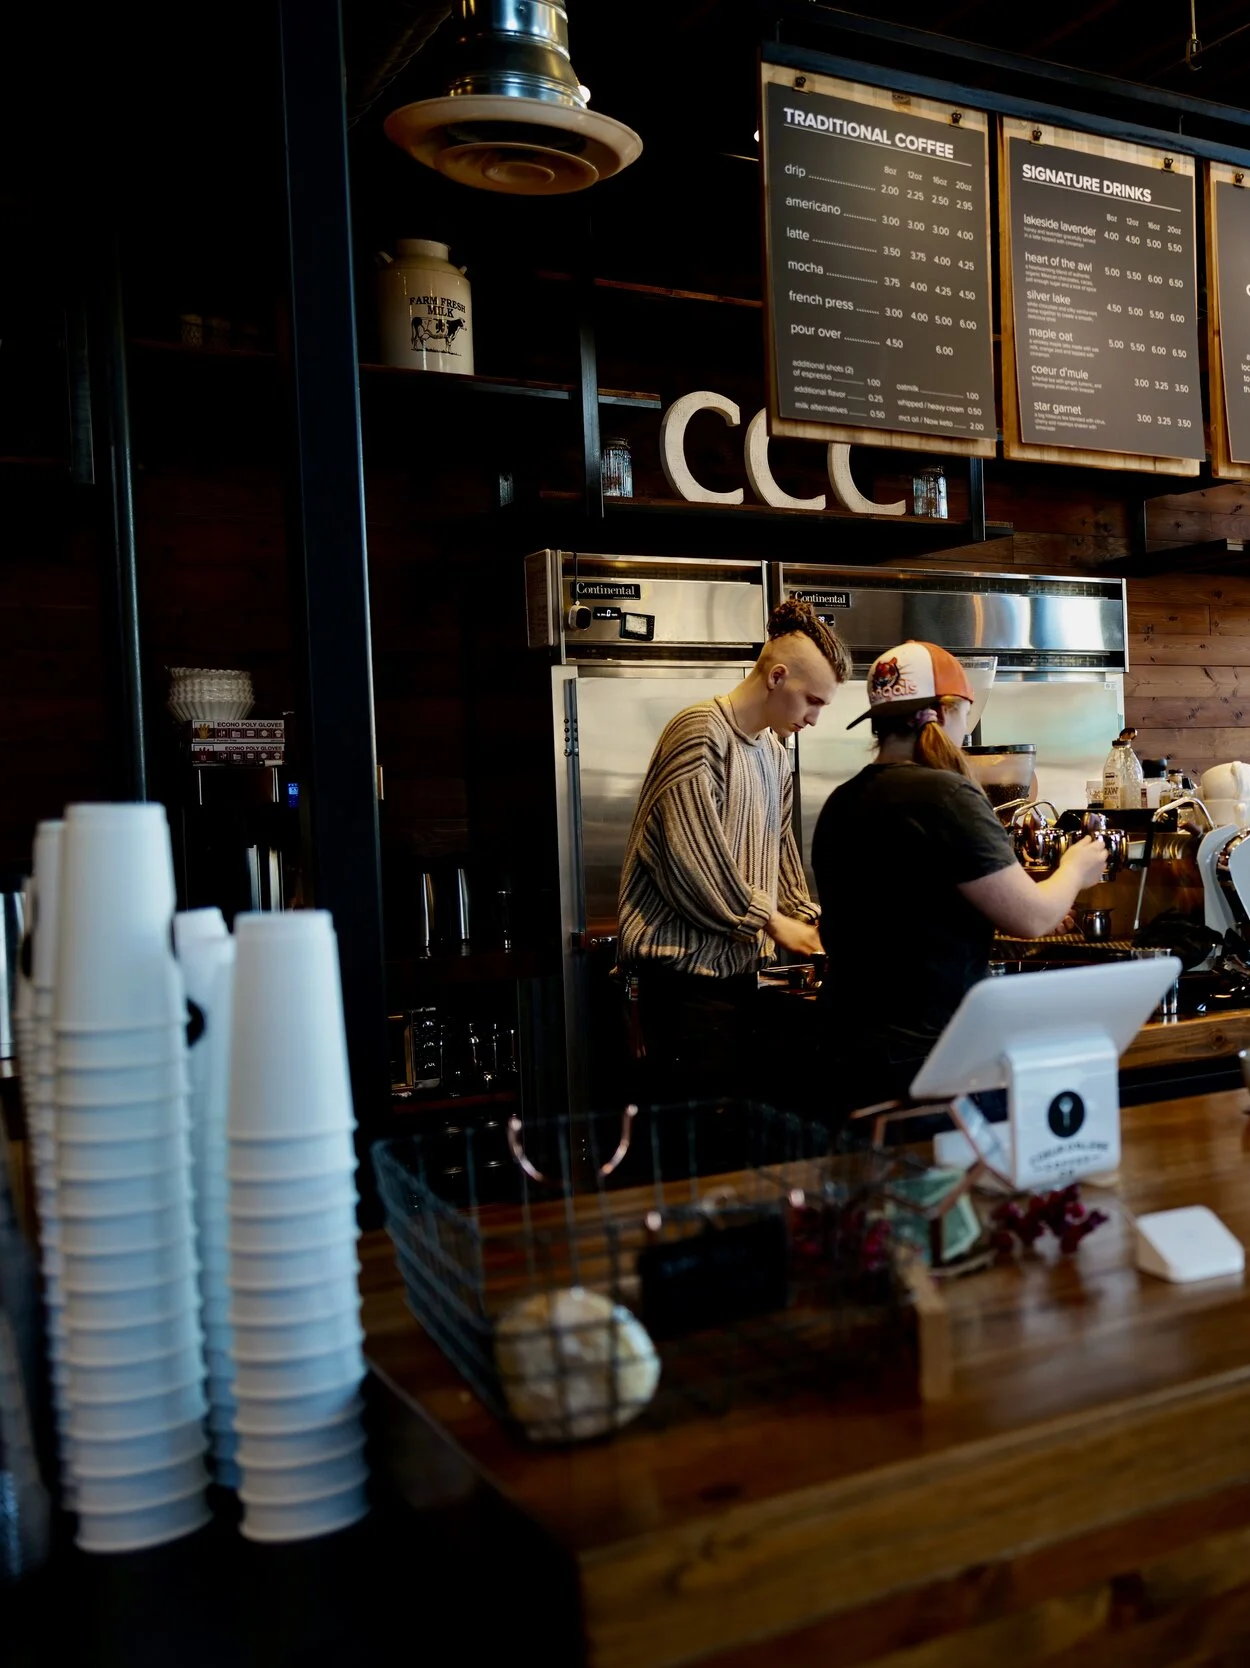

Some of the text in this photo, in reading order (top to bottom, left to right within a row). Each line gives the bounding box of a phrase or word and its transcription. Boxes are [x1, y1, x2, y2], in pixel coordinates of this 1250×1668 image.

[784, 108, 953, 158] TRADITIONAL COFFEE
[884, 166, 972, 191] 8oz 12oz 16oz 20oz
[1022, 164, 1151, 202] SIGNATURE DRINKS
[785, 164, 973, 211] drip 2.00 2.25 2.50 2.95
[786, 197, 841, 215] americano
[787, 227, 810, 241] latte
[1024, 214, 1059, 230] lakeside
[1060, 221, 1096, 236] lavender
[1104, 231, 1119, 241] 4.00
[1125, 235, 1140, 245] 4.50
[1146, 238, 1162, 249] 5.00
[1168, 243, 1182, 253] 5.50
[788, 261, 823, 274] mocha
[1025, 252, 1092, 272] heart of the awl
[409, 296, 466, 313] FARM FRESH
[789, 290, 854, 310] french press
[1027, 290, 1071, 305] silver lake
[428, 305, 454, 318] MILK
[791, 324, 841, 339] pour over
[1029, 328, 1073, 342] maple oat
[1031, 365, 1089, 380] coeur d'mule
[1034, 401, 1191, 428] star garnet 3.00 3.25 3.50
[576, 582, 635, 595] Continental
[795, 591, 846, 603] Continental
